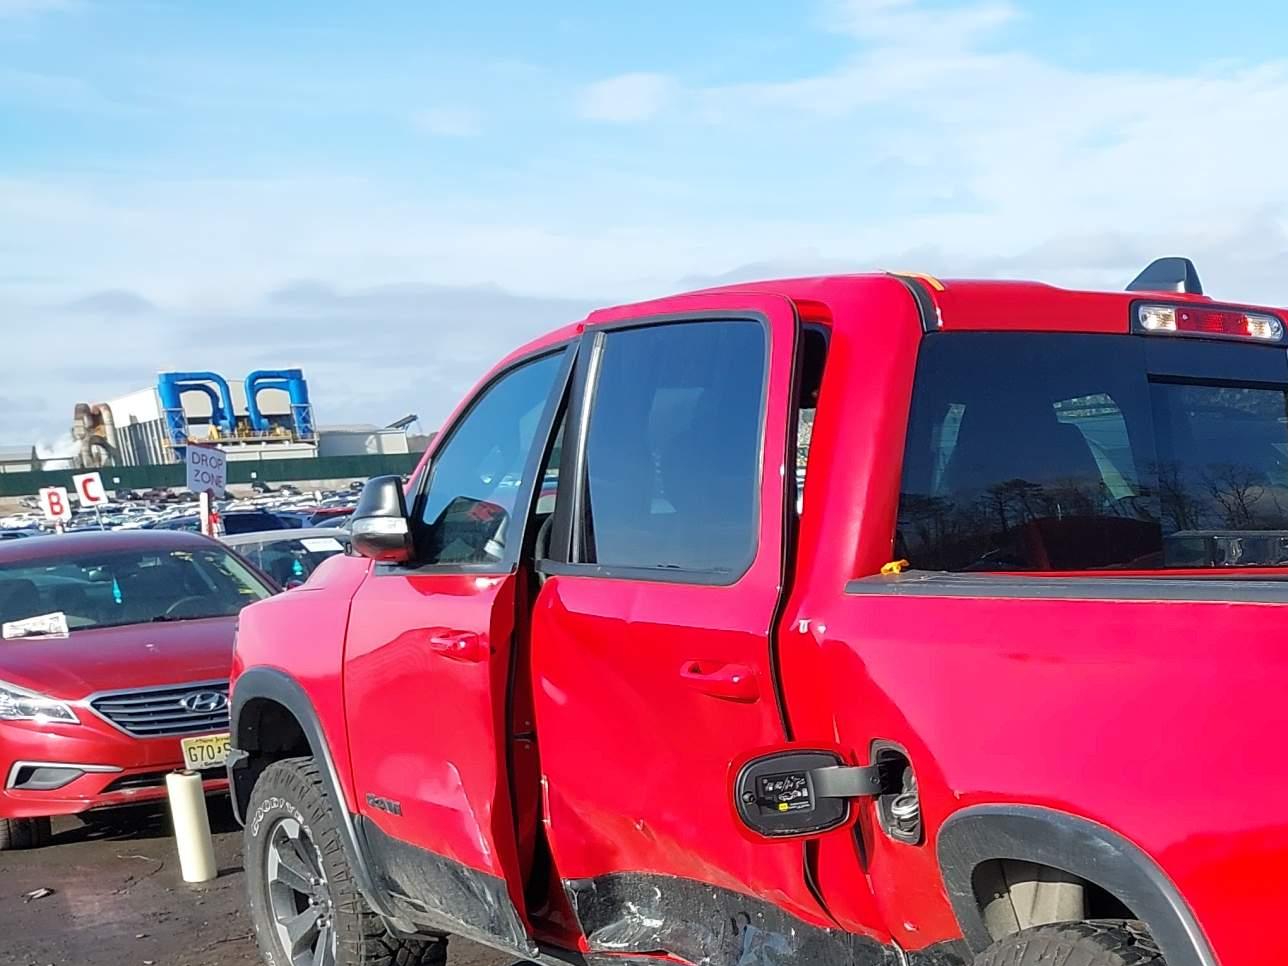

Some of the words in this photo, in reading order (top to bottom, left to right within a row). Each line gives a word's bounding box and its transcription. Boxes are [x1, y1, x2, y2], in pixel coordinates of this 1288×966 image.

[191, 451, 223, 471] DROP
[82, 478, 100, 502] C
[193, 471, 223, 489] ZONE
[47, 491, 65, 516] B
